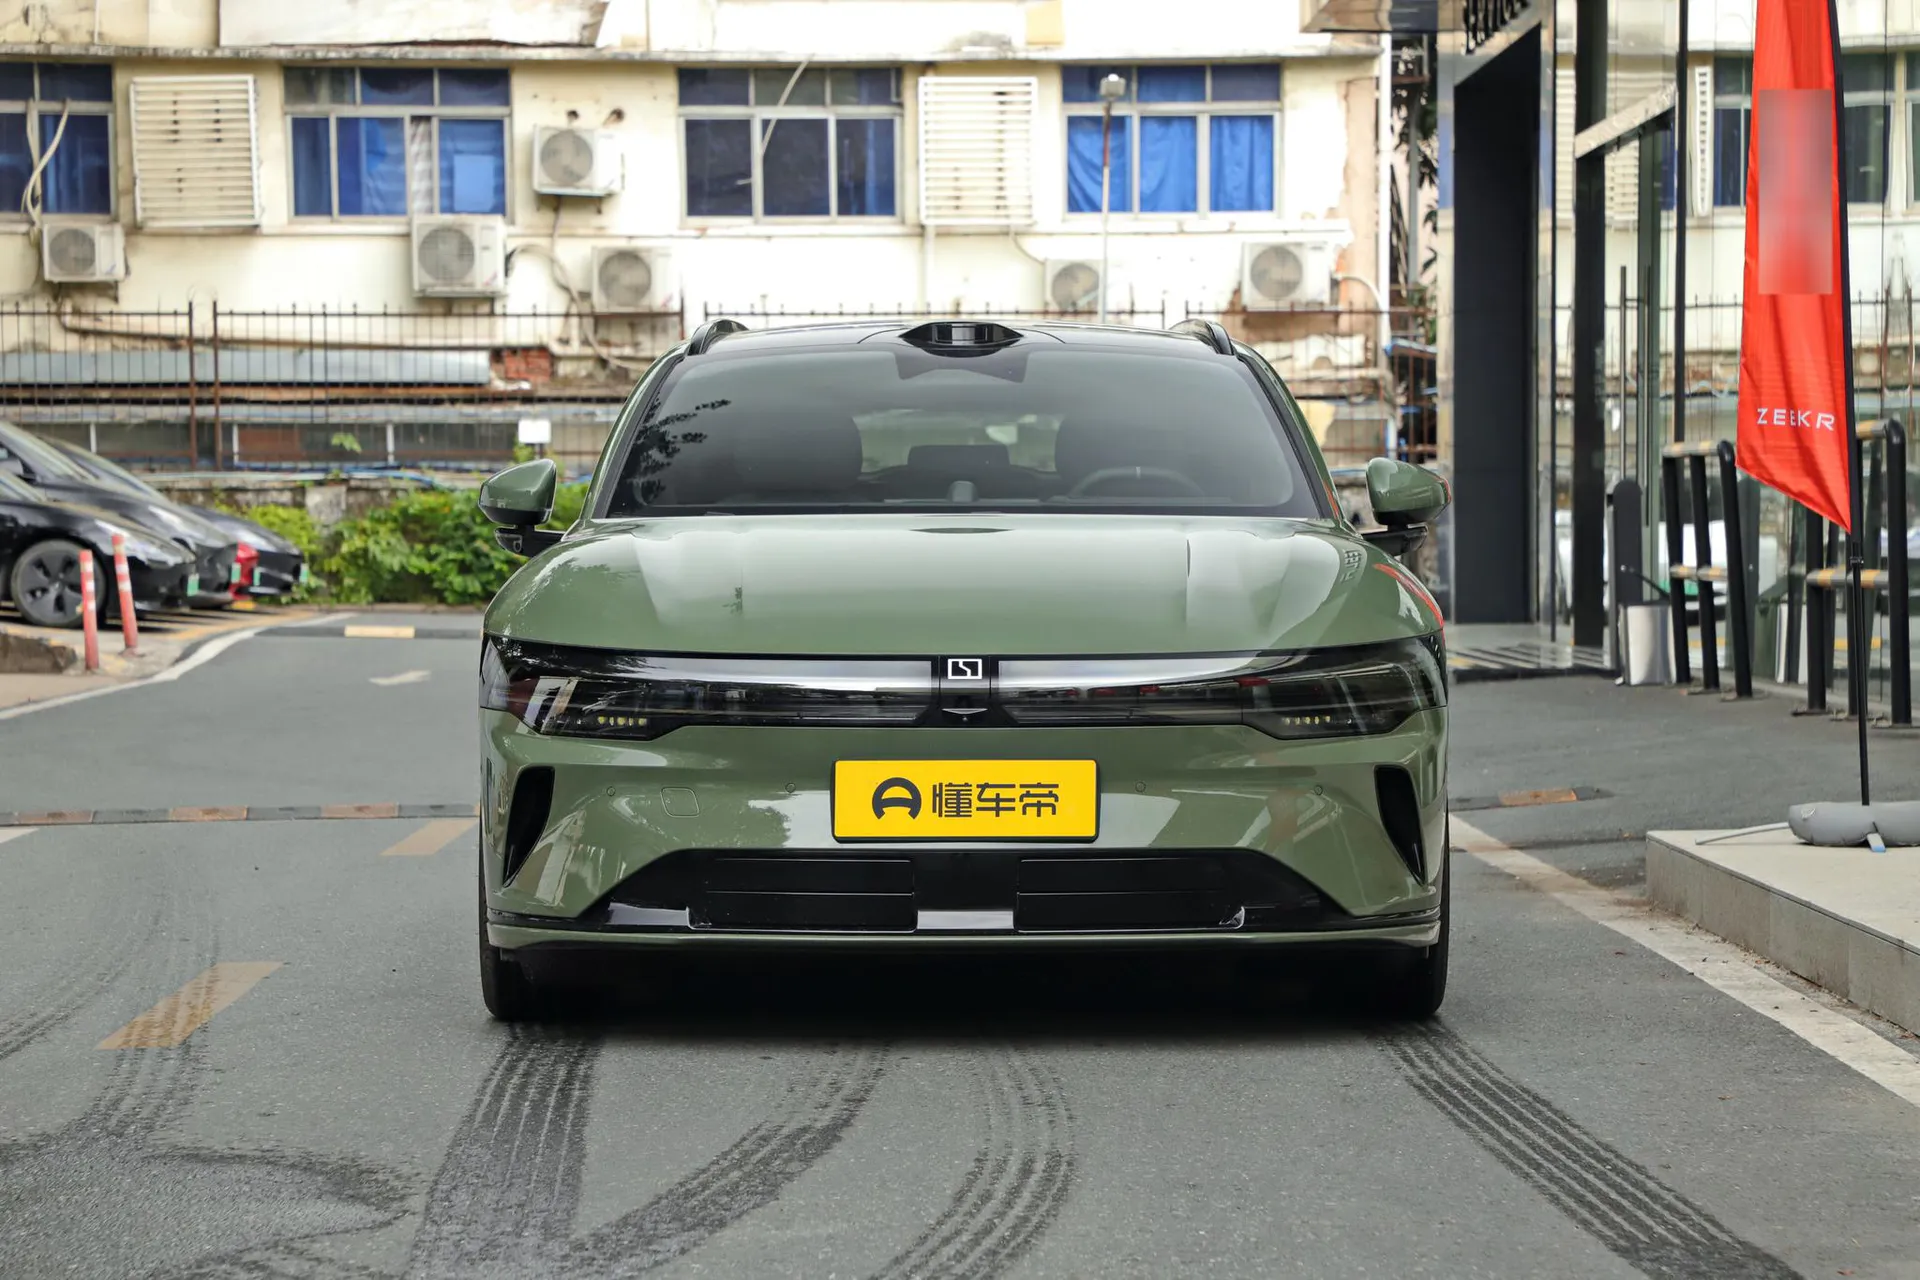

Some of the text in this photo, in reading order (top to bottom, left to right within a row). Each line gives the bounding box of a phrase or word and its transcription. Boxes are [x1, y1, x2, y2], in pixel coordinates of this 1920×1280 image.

[1756, 407, 1835, 431] ZEEKR
[932, 782, 1059, 817] 懂车帝
